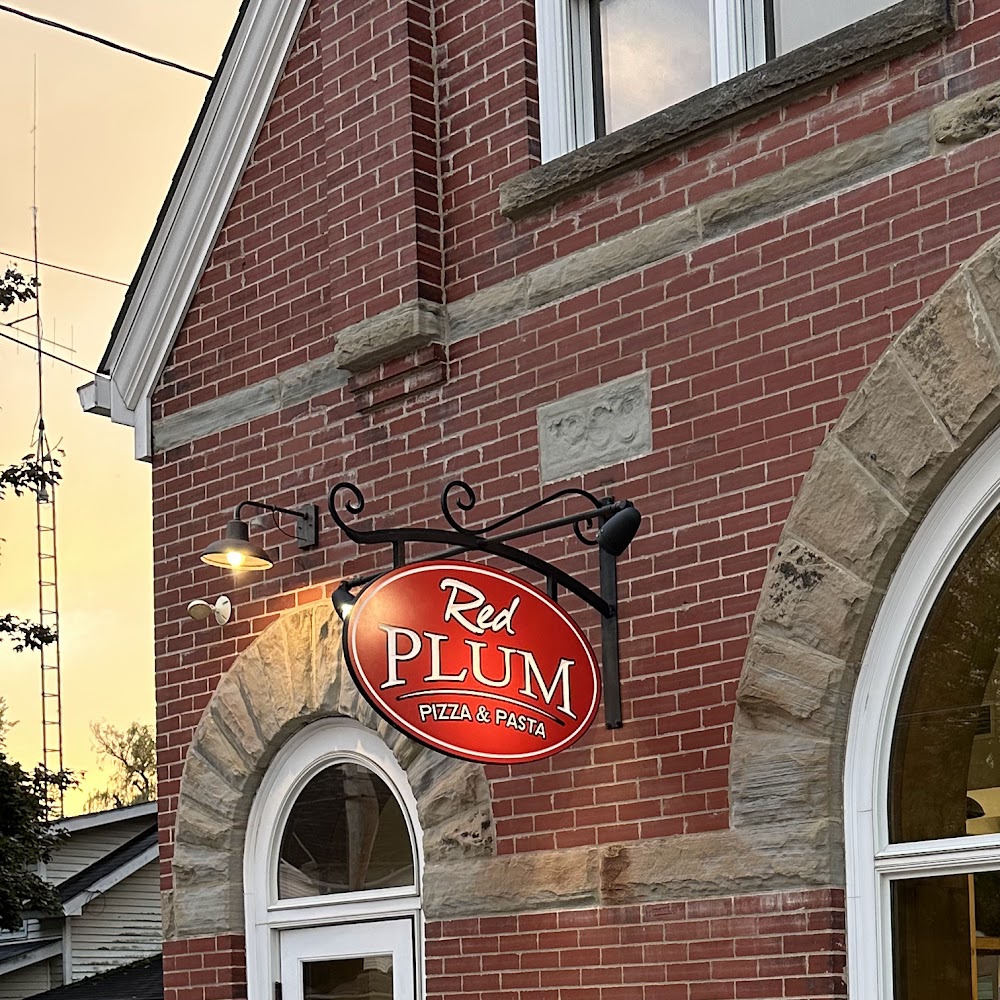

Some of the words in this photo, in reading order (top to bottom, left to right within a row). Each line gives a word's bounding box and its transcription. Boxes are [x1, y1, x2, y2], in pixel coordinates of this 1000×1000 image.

[440, 578, 520, 635] Red
[379, 623, 577, 719] PLUM
[419, 704, 472, 722] PIZZA
[475, 705, 491, 723] &
[495, 709, 546, 738] PASTA
